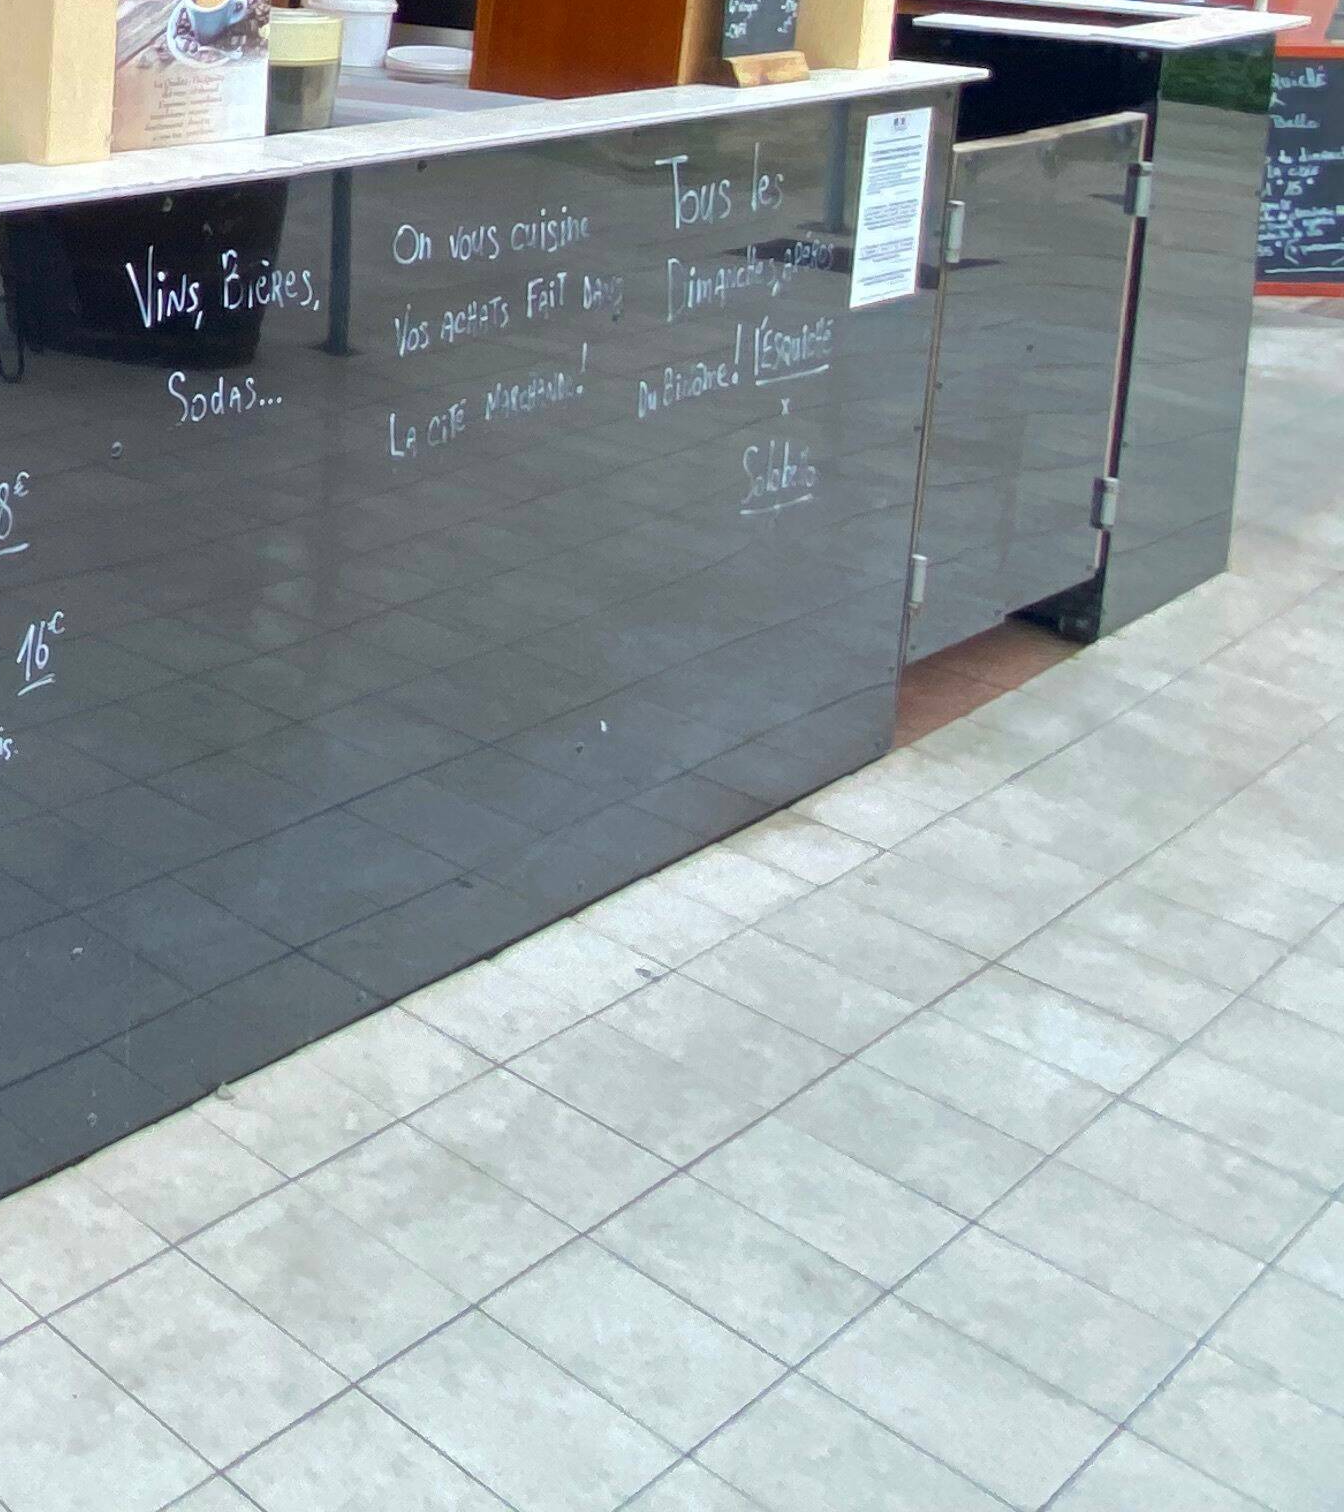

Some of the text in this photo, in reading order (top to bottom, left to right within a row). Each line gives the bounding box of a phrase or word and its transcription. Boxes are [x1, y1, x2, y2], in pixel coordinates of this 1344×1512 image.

[654, 154, 732, 230] Tous
[750, 142, 785, 212] les
[392, 206, 591, 265] On vous cuisine
[394, 303, 431, 358] Vos
